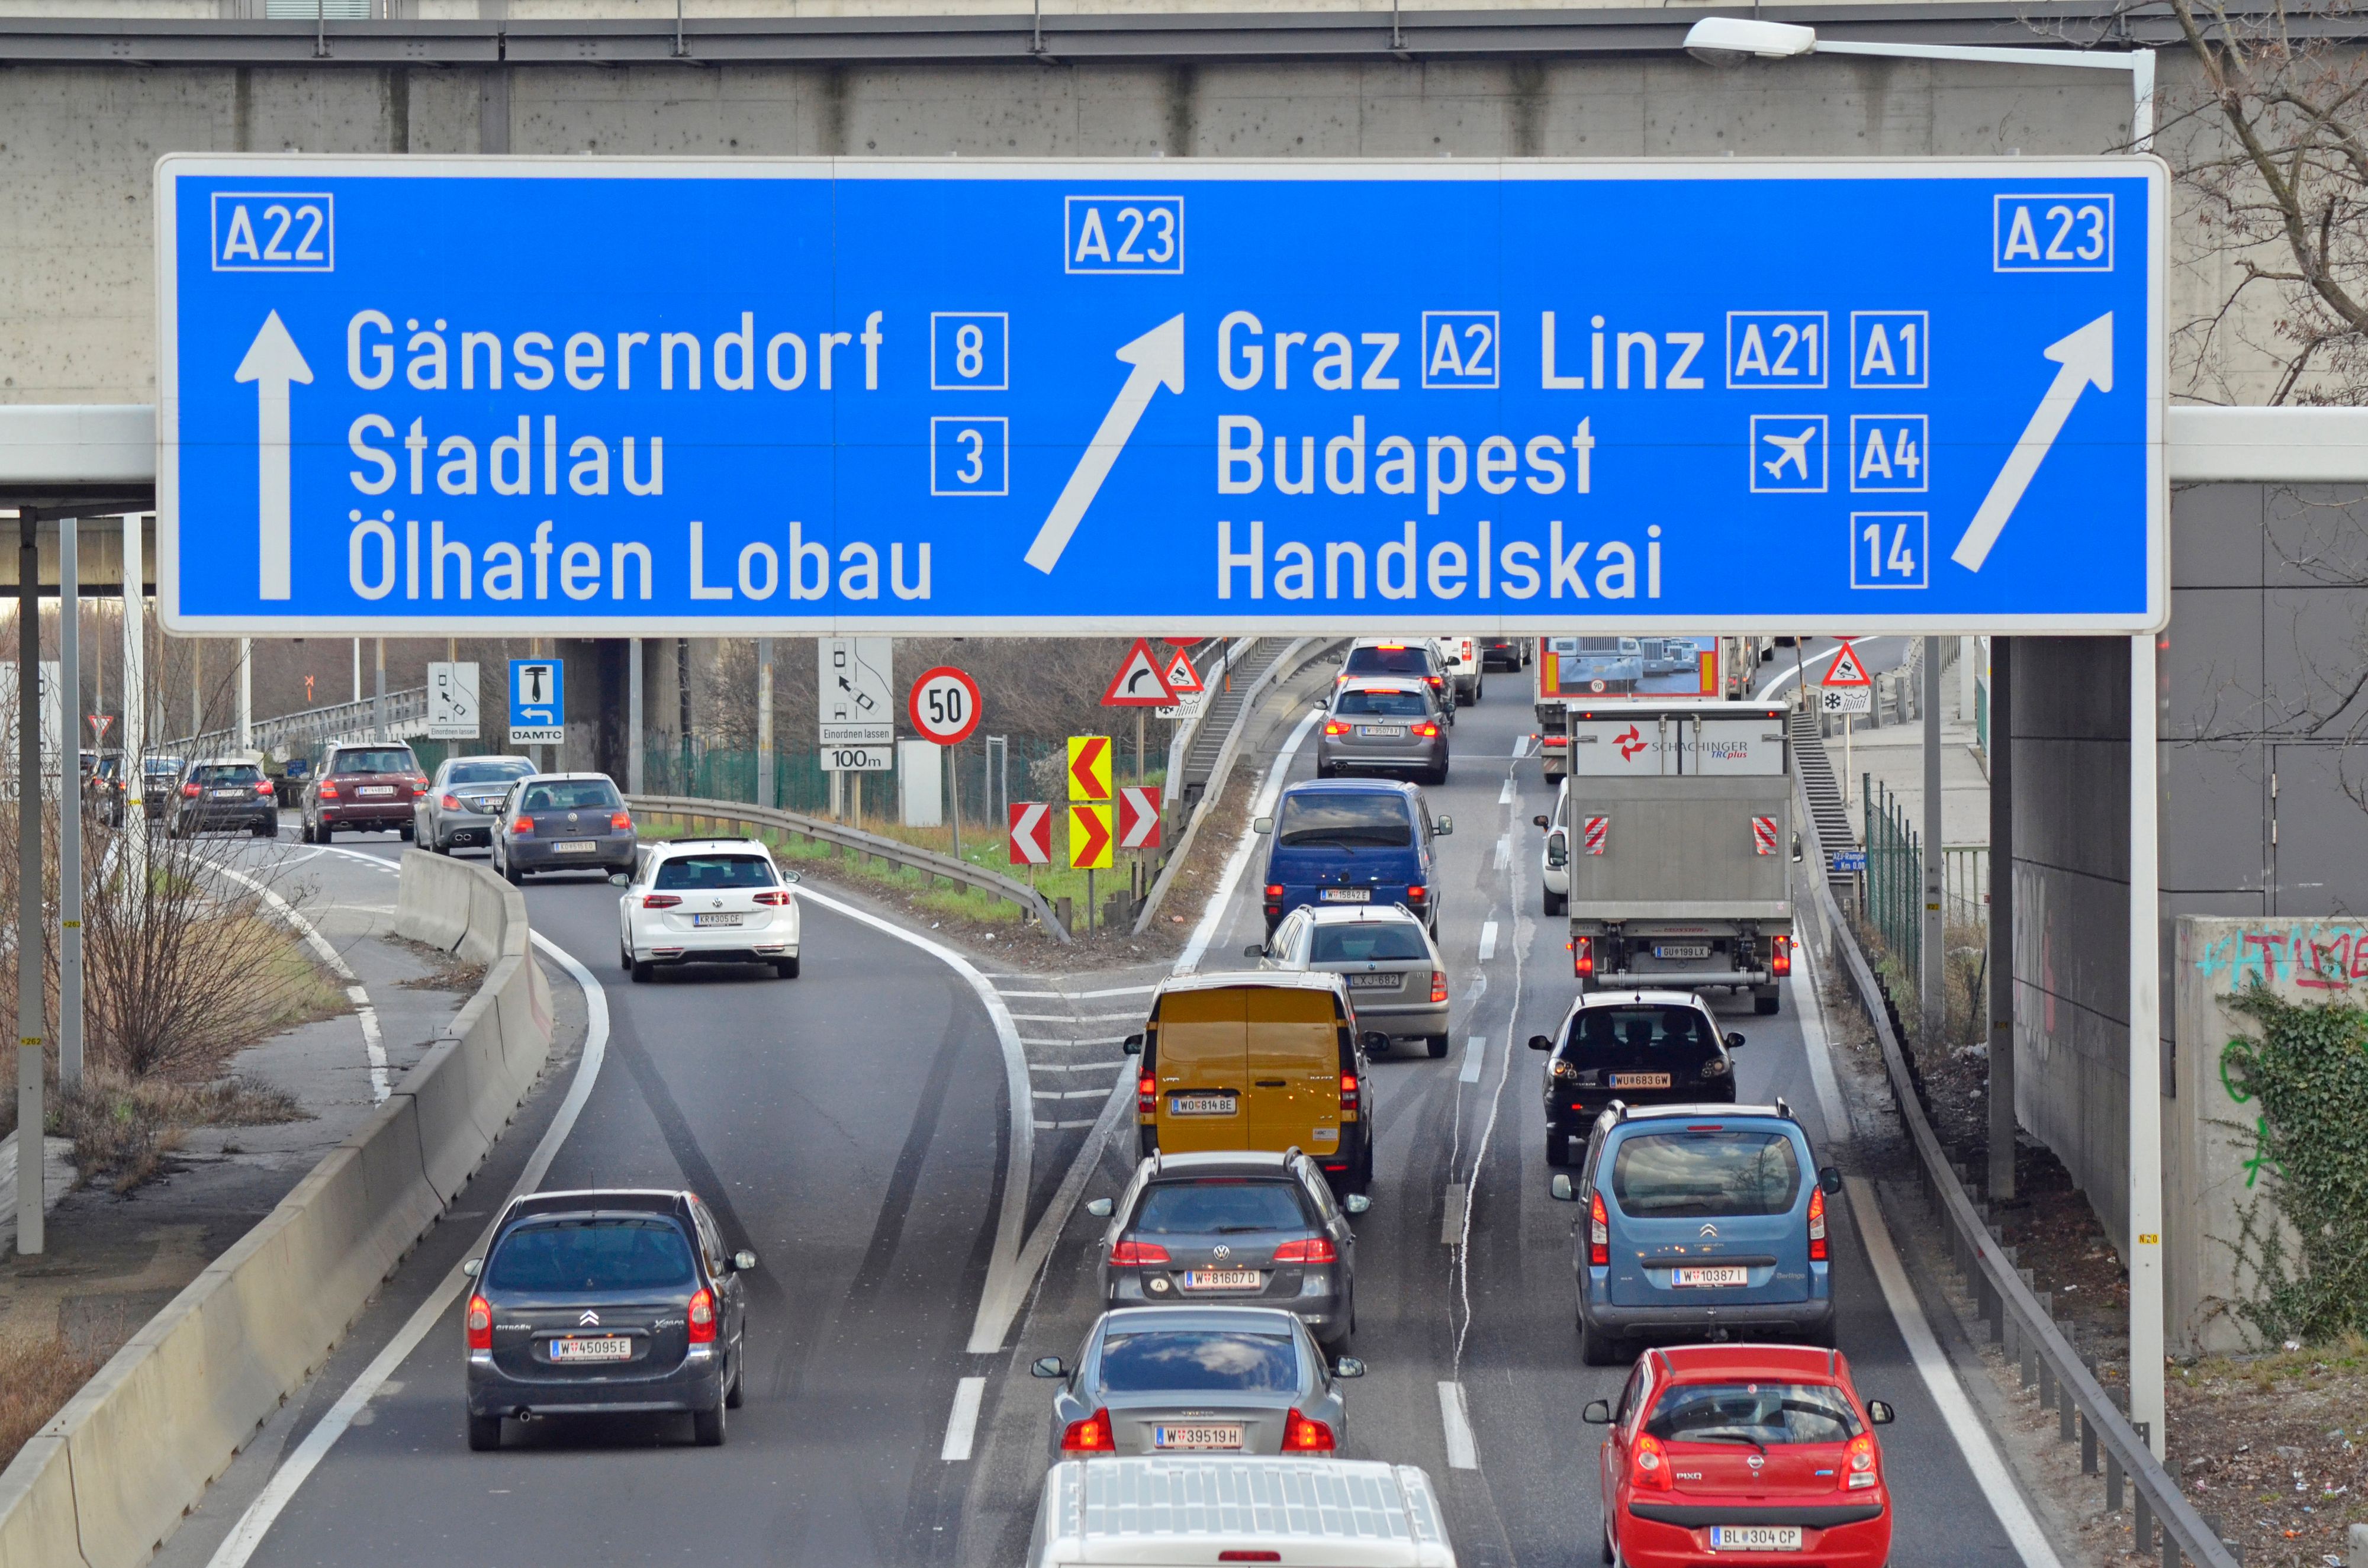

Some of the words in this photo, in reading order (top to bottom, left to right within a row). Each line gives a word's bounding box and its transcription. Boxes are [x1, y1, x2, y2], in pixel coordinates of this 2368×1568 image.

[224, 205, 323, 260] A22
[1076, 208, 1175, 262] A23
[2005, 206, 2104, 260] A23
[348, 310, 883, 391] Gänserndorf
[957, 325, 983, 377] 8
[1219, 311, 1399, 391] Graz
[1430, 324, 1492, 376] A2
[1542, 311, 1704, 389] Linz
[1736, 324, 1817, 376] A21
[1862, 324, 1916, 376] A1
[349, 414, 663, 496] Stadlau
[957, 430, 983, 484] 3
[1859, 429, 1920, 478] A4
[1218, 416, 1595, 515] Budapest
[349, 510, 652, 600] Ölhafen
[690, 521, 931, 600] Lobau
[1864, 524, 1915, 577] 14
[1218, 521, 1661, 600] Handelskai
[929, 688, 961, 723] 50
[512, 731, 562, 739] ÖAMTC
[824, 729, 863, 739] Einordnen
[864, 729, 889, 738] lassen
[1652, 741, 1748, 752] SCHACHINGER
[832, 750, 867, 767] 100
[868, 758, 881, 767] m
[1711, 751, 1748, 760] TRCplus
[700, 915, 710, 923] KR
[716, 915, 729, 923] 305
[731, 914, 740, 922] CF
[1353, 975, 1397, 986] LXJ-682
[1616, 1076, 1629, 1085] WU
[1636, 1076, 1653, 1085] 683
[1655, 1076, 1668, 1084] GW
[1201, 1100, 1218, 1110] 814
[1220, 1100, 1232, 1110] BE
[1156, 1280, 1163, 1289] A
[1196, 1273, 1203, 1283] W
[1212, 1273, 1244, 1284] 81607
[1249, 1273, 1255, 1283] D
[1684, 1271, 1692, 1282] W
[1701, 1270, 1733, 1282] 10387
[561, 1342, 570, 1355] W
[580, 1341, 617, 1354] 45095
[620, 1340, 626, 1353] E
[1167, 1429, 1176, 1443] W
[1187, 1429, 1226, 1443] 39519
[1230, 1429, 1237, 1443] H
[1724, 1530, 1739, 1543] BL
[1751, 1530, 1775, 1544] 304
[1779, 1530, 1796, 1544] CP
